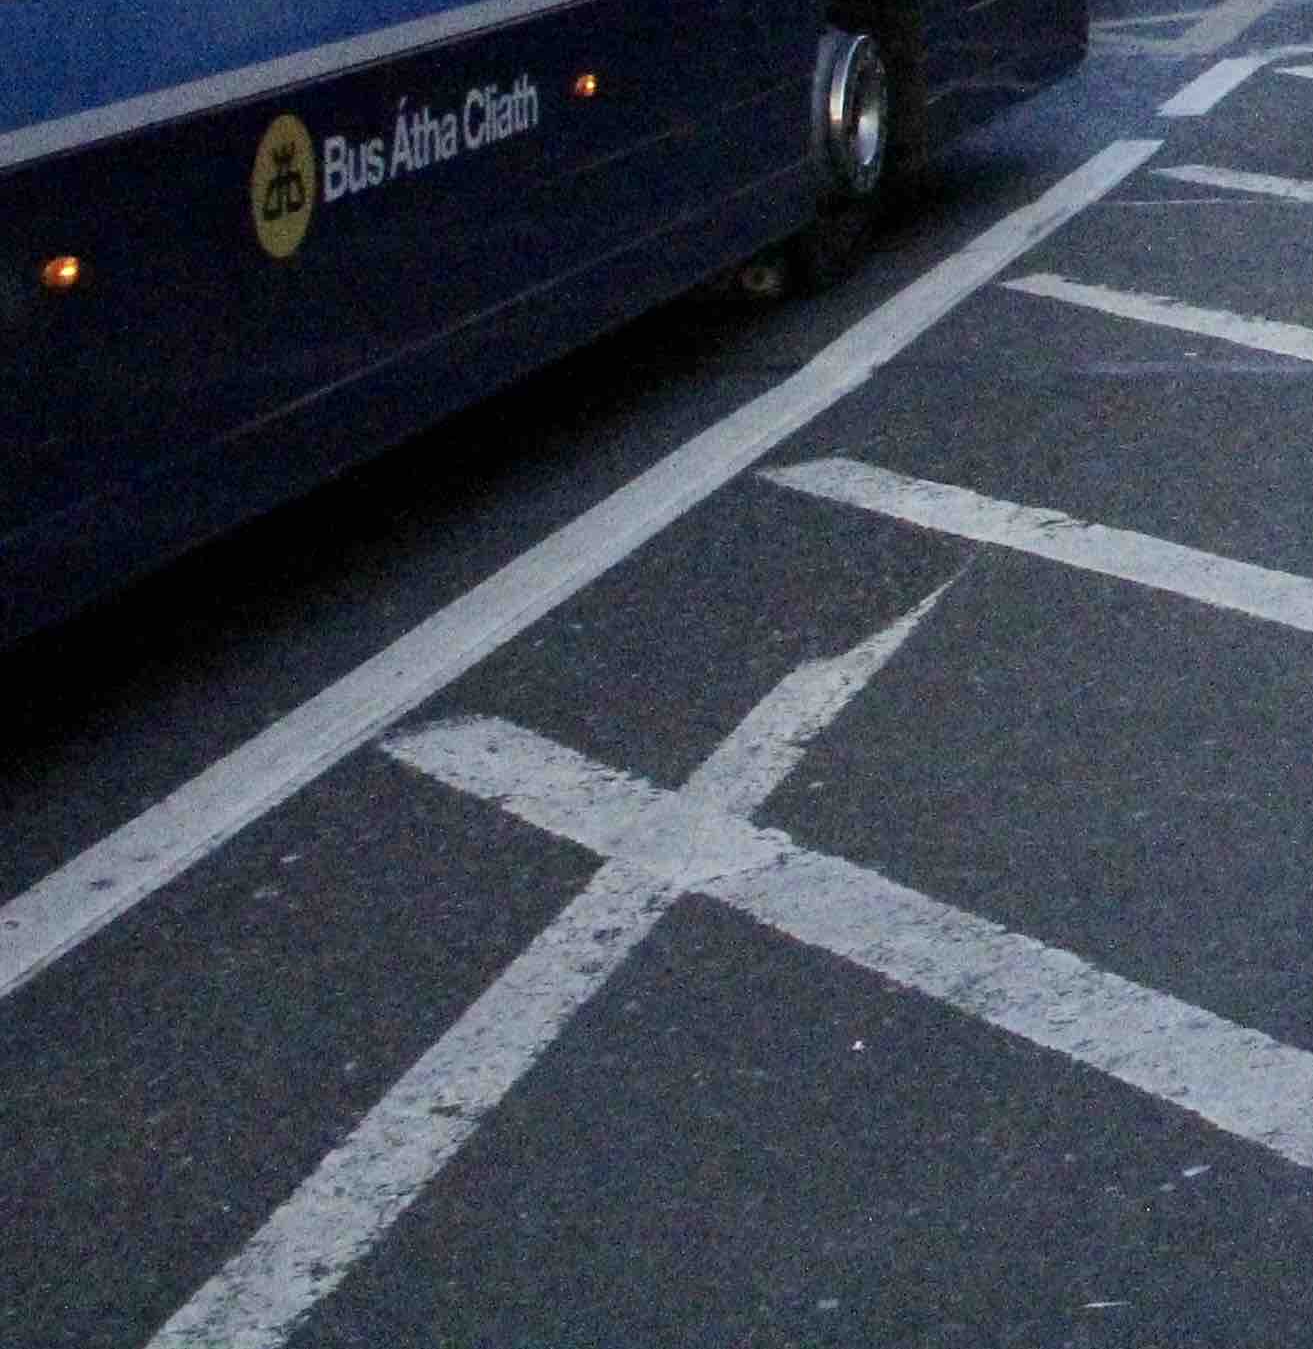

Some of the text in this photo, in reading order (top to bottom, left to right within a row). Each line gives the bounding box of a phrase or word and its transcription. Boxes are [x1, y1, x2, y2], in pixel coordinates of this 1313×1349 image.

[323, 72, 540, 203] Bus Átha Cliath
